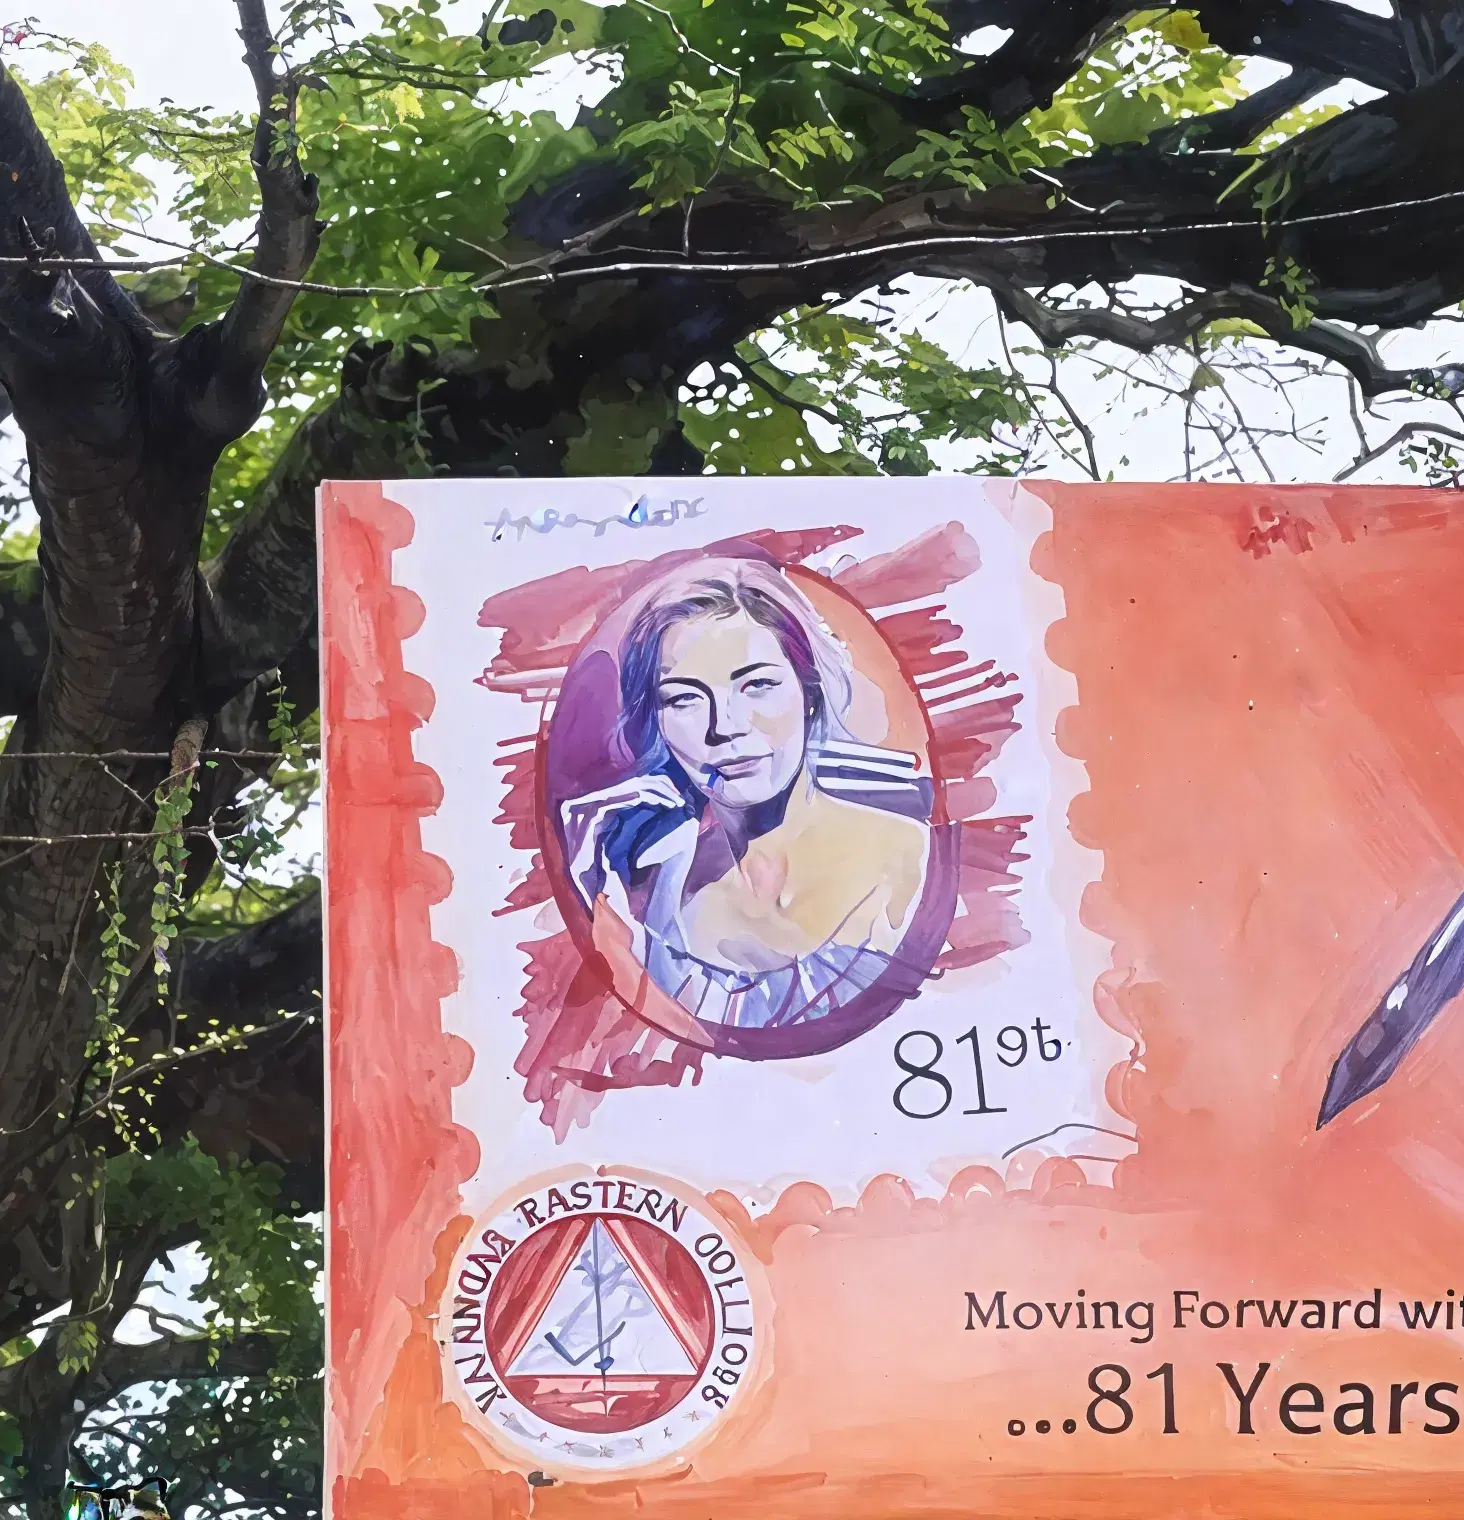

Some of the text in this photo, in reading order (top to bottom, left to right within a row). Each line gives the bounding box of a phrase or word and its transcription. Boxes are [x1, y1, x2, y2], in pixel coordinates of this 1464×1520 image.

[964, 1289, 1154, 1343] Moving
[1173, 1288, 1381, 1330] Forward
[1216, 1362, 1460, 1435] Years
